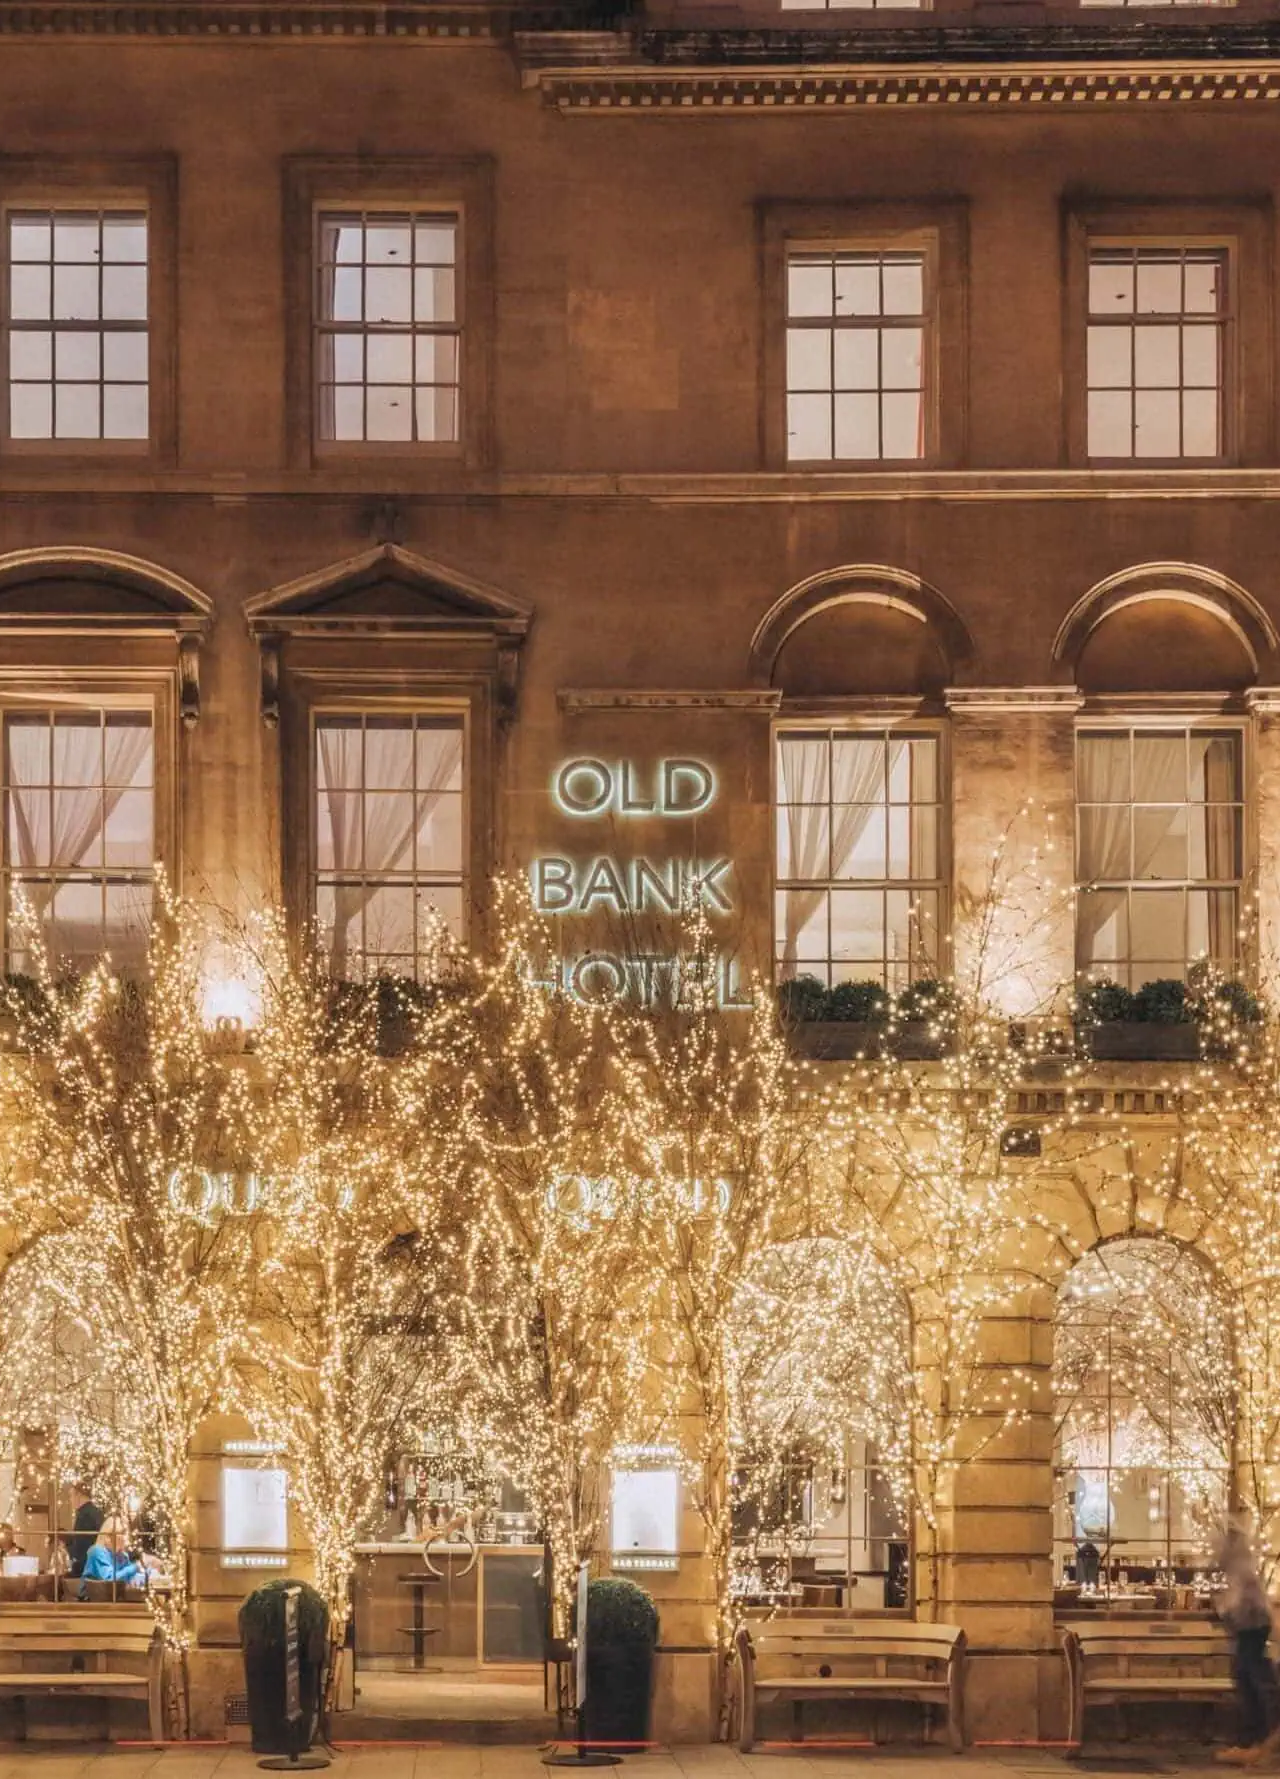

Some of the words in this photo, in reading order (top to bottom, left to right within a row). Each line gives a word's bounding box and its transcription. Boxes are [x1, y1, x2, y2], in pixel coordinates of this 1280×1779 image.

[556, 757, 714, 814] OLD
[534, 856, 734, 912] BANK
[517, 953, 755, 1009] HOTEL
[167, 1165, 355, 1229] QU
